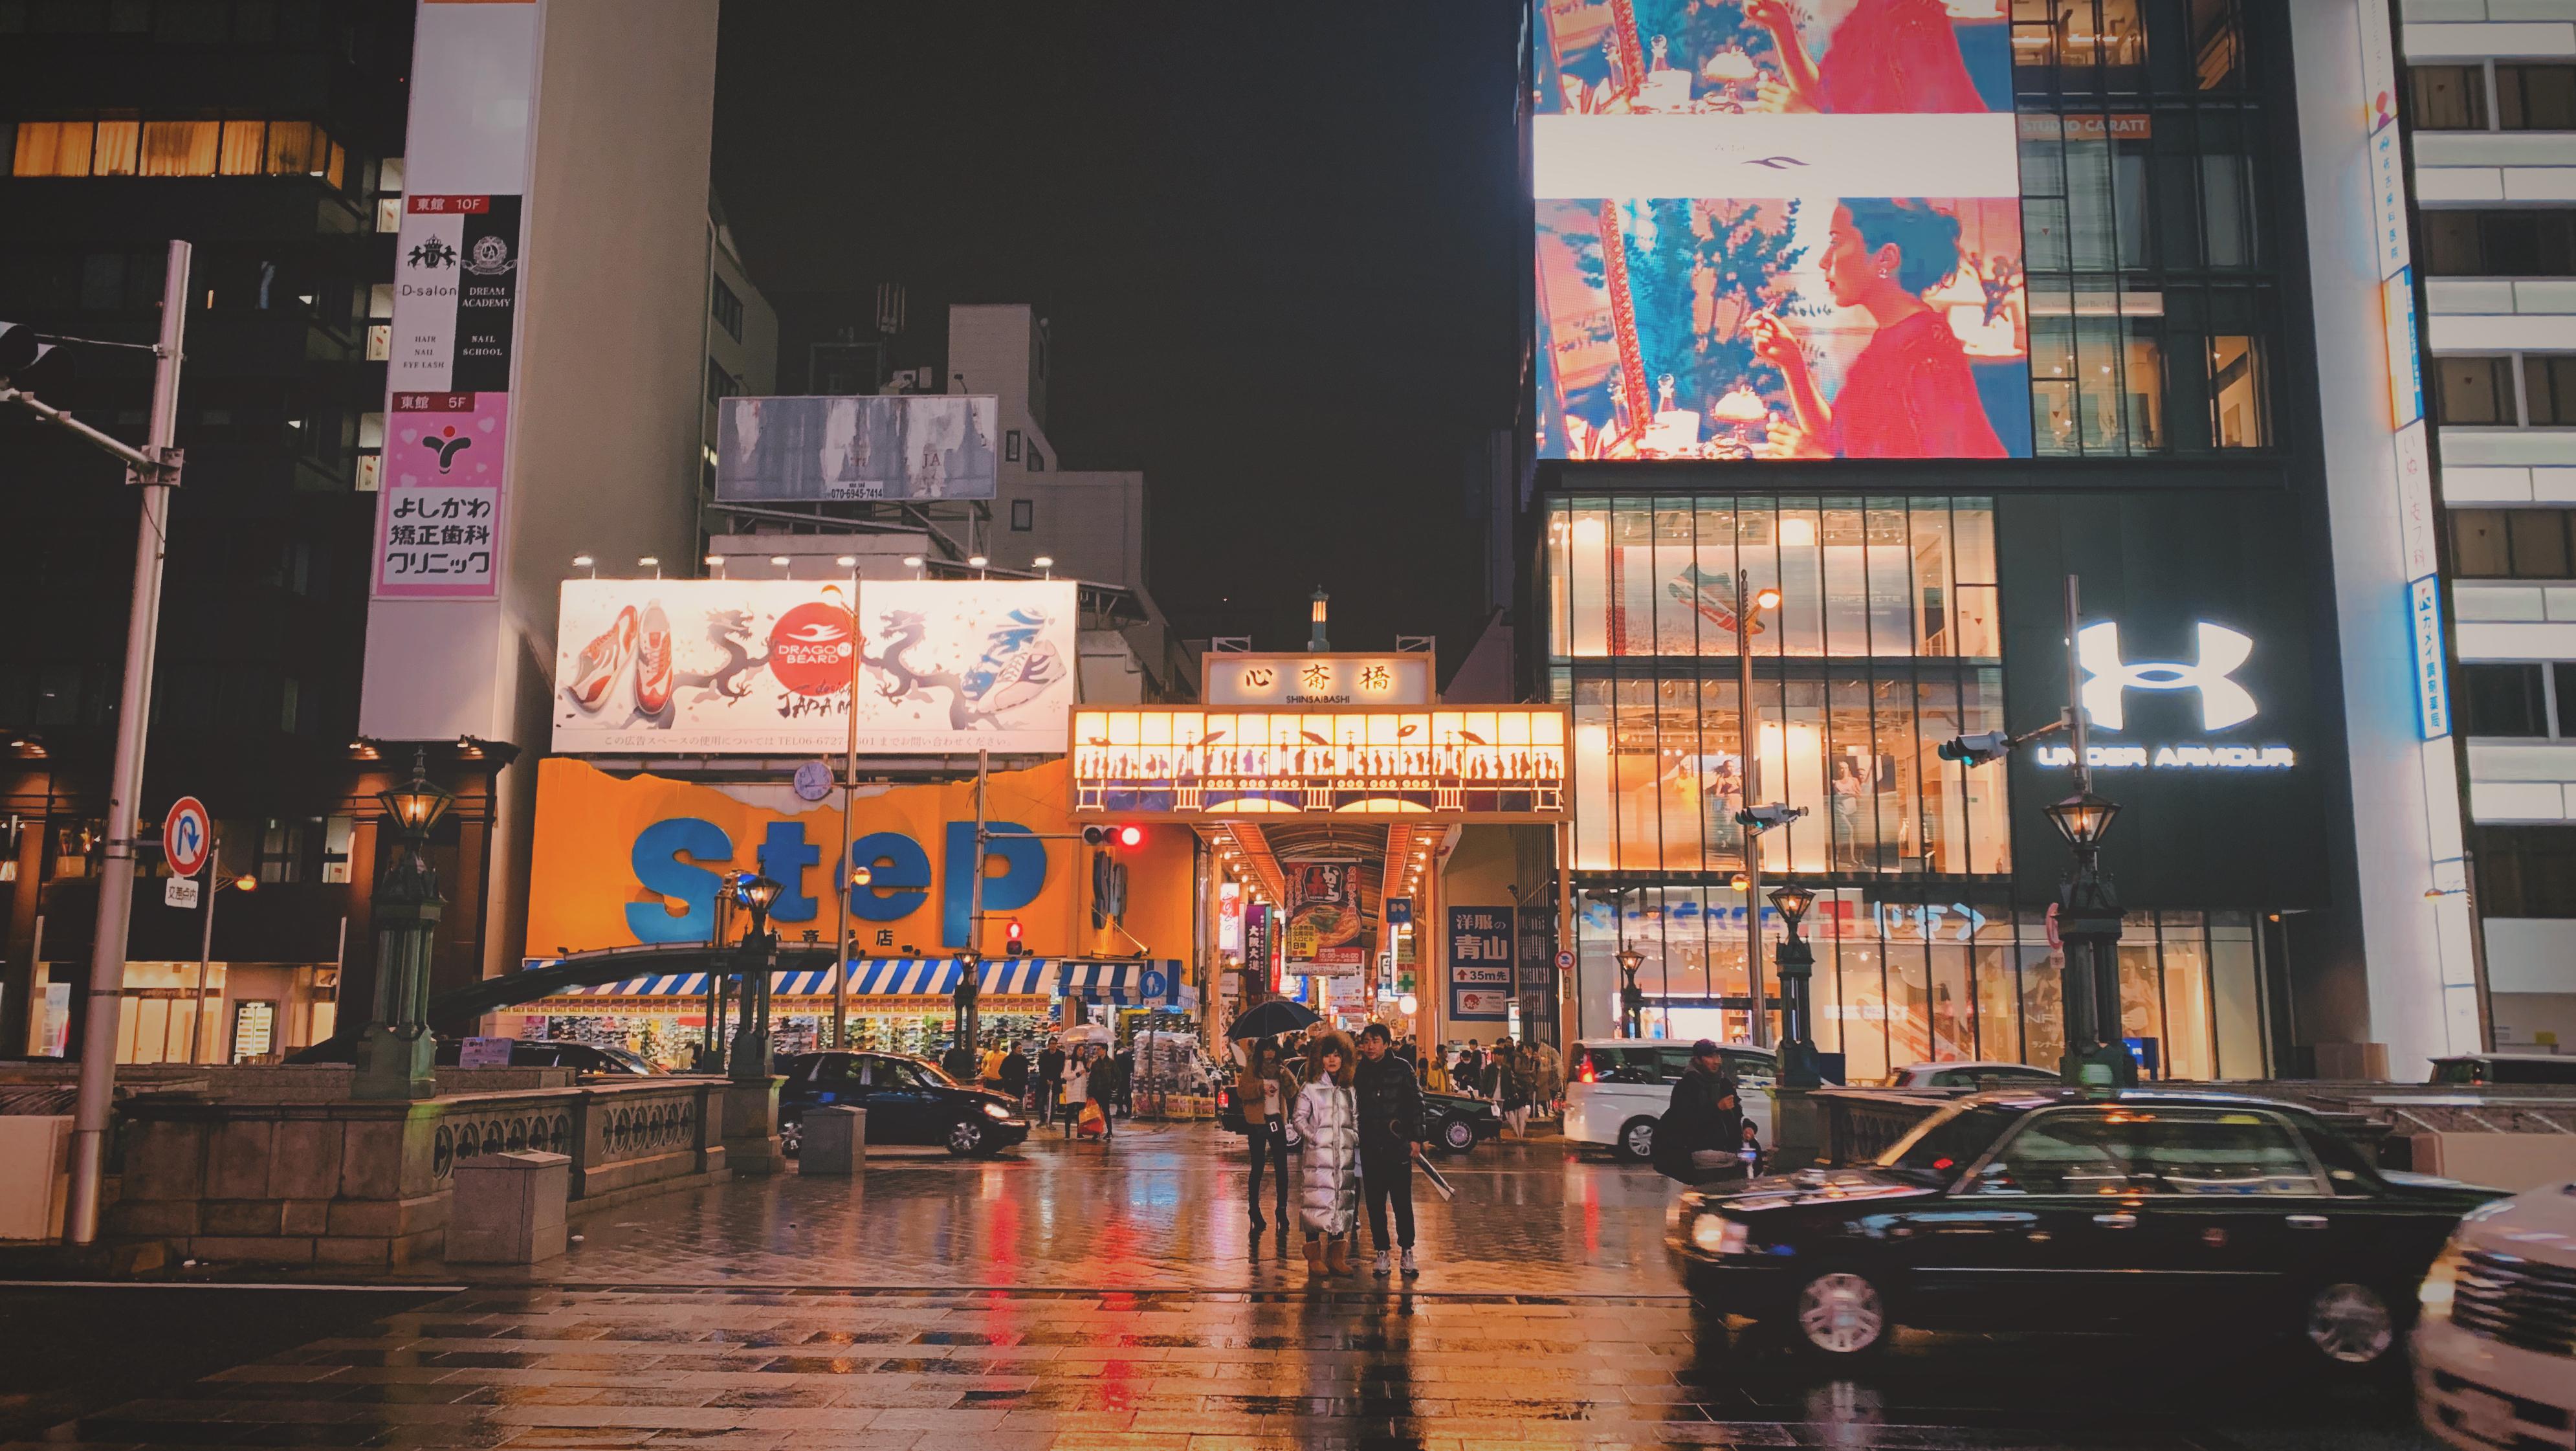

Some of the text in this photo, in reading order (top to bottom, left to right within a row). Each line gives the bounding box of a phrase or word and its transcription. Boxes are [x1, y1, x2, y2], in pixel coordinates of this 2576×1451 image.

[2021, 119, 2146, 132] STUDIO CARATT
[416, 198, 481, 211] 東館 10F
[402, 284, 457, 297] D-salon
[469, 287, 505, 296] DREAM
[462, 298, 511, 307] ACADEMY
[471, 335, 496, 344] NAIL
[401, 395, 467, 409] 東館 5F
[831, 488, 883, 499] 070-6945-7414
[393, 497, 490, 518] よしかわ
[389, 524, 490, 546] 矯正歯科
[386, 551, 490, 574] クリニック
[778, 643, 852, 656] DRAGON
[786, 655, 839, 664] BEARD
[1246, 664, 1391, 691] 心斎橋
[1286, 695, 1350, 704] SHINSAIBASHI
[2038, 747, 2294, 768] UNDER ARMOUR
[168, 885, 197, 902] 交差点内
[1455, 914, 1506, 930] 洋服の
[1454, 934, 1508, 960] 青山
[1470, 970, 1507, 981] 35m先
